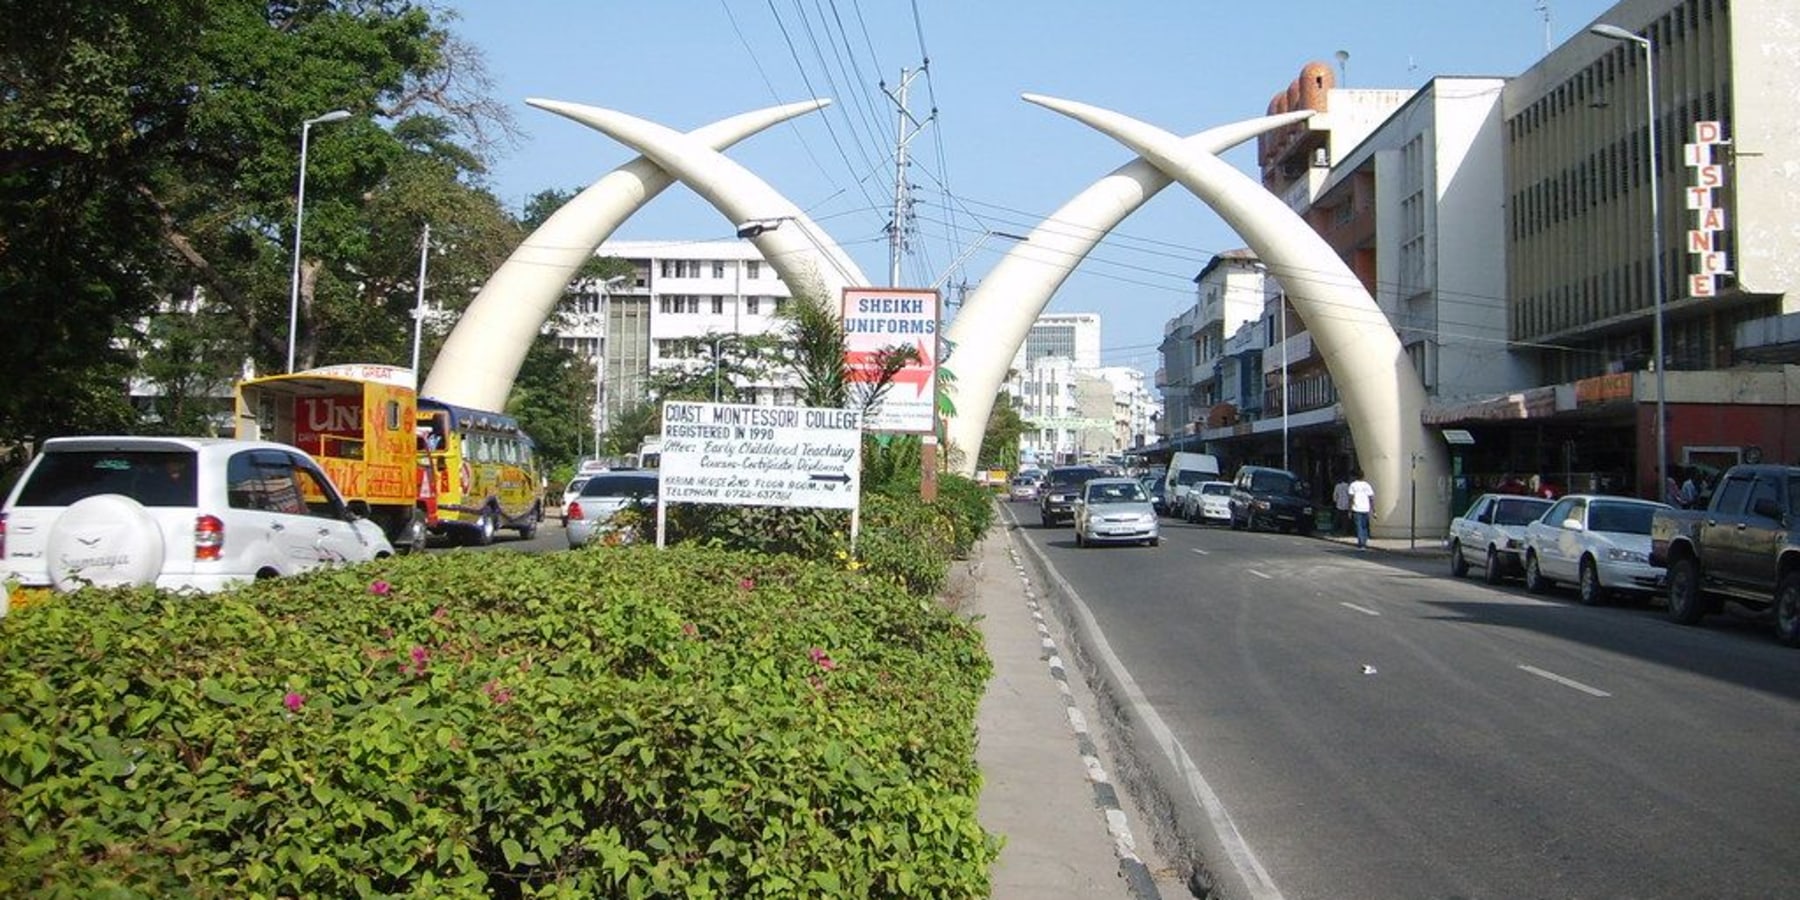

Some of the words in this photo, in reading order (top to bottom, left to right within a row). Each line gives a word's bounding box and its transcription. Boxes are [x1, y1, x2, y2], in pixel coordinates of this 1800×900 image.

[1691, 122, 1720, 295] DISTANCE
[858, 298, 923, 314] SHEIKH
[844, 318, 935, 334] UNIFORMS
[362, 366, 393, 379] GREAT
[305, 400, 364, 431] UN
[666, 404, 703, 423] COAST
[713, 407, 799, 429] MONTESSORI
[806, 411, 860, 430] COLLEGE
[665, 425, 731, 439] REGISTERED
[734, 427, 746, 439] IN
[750, 428, 774, 440] 1990
[704, 441, 736, 457] Early
[738, 442, 799, 456] Childhood
[802, 443, 855, 463] Teaching
[797, 458, 845, 472] Diploma
[666, 487, 720, 498] TELEPHONE
[60, 553, 131, 568] Sumaya
